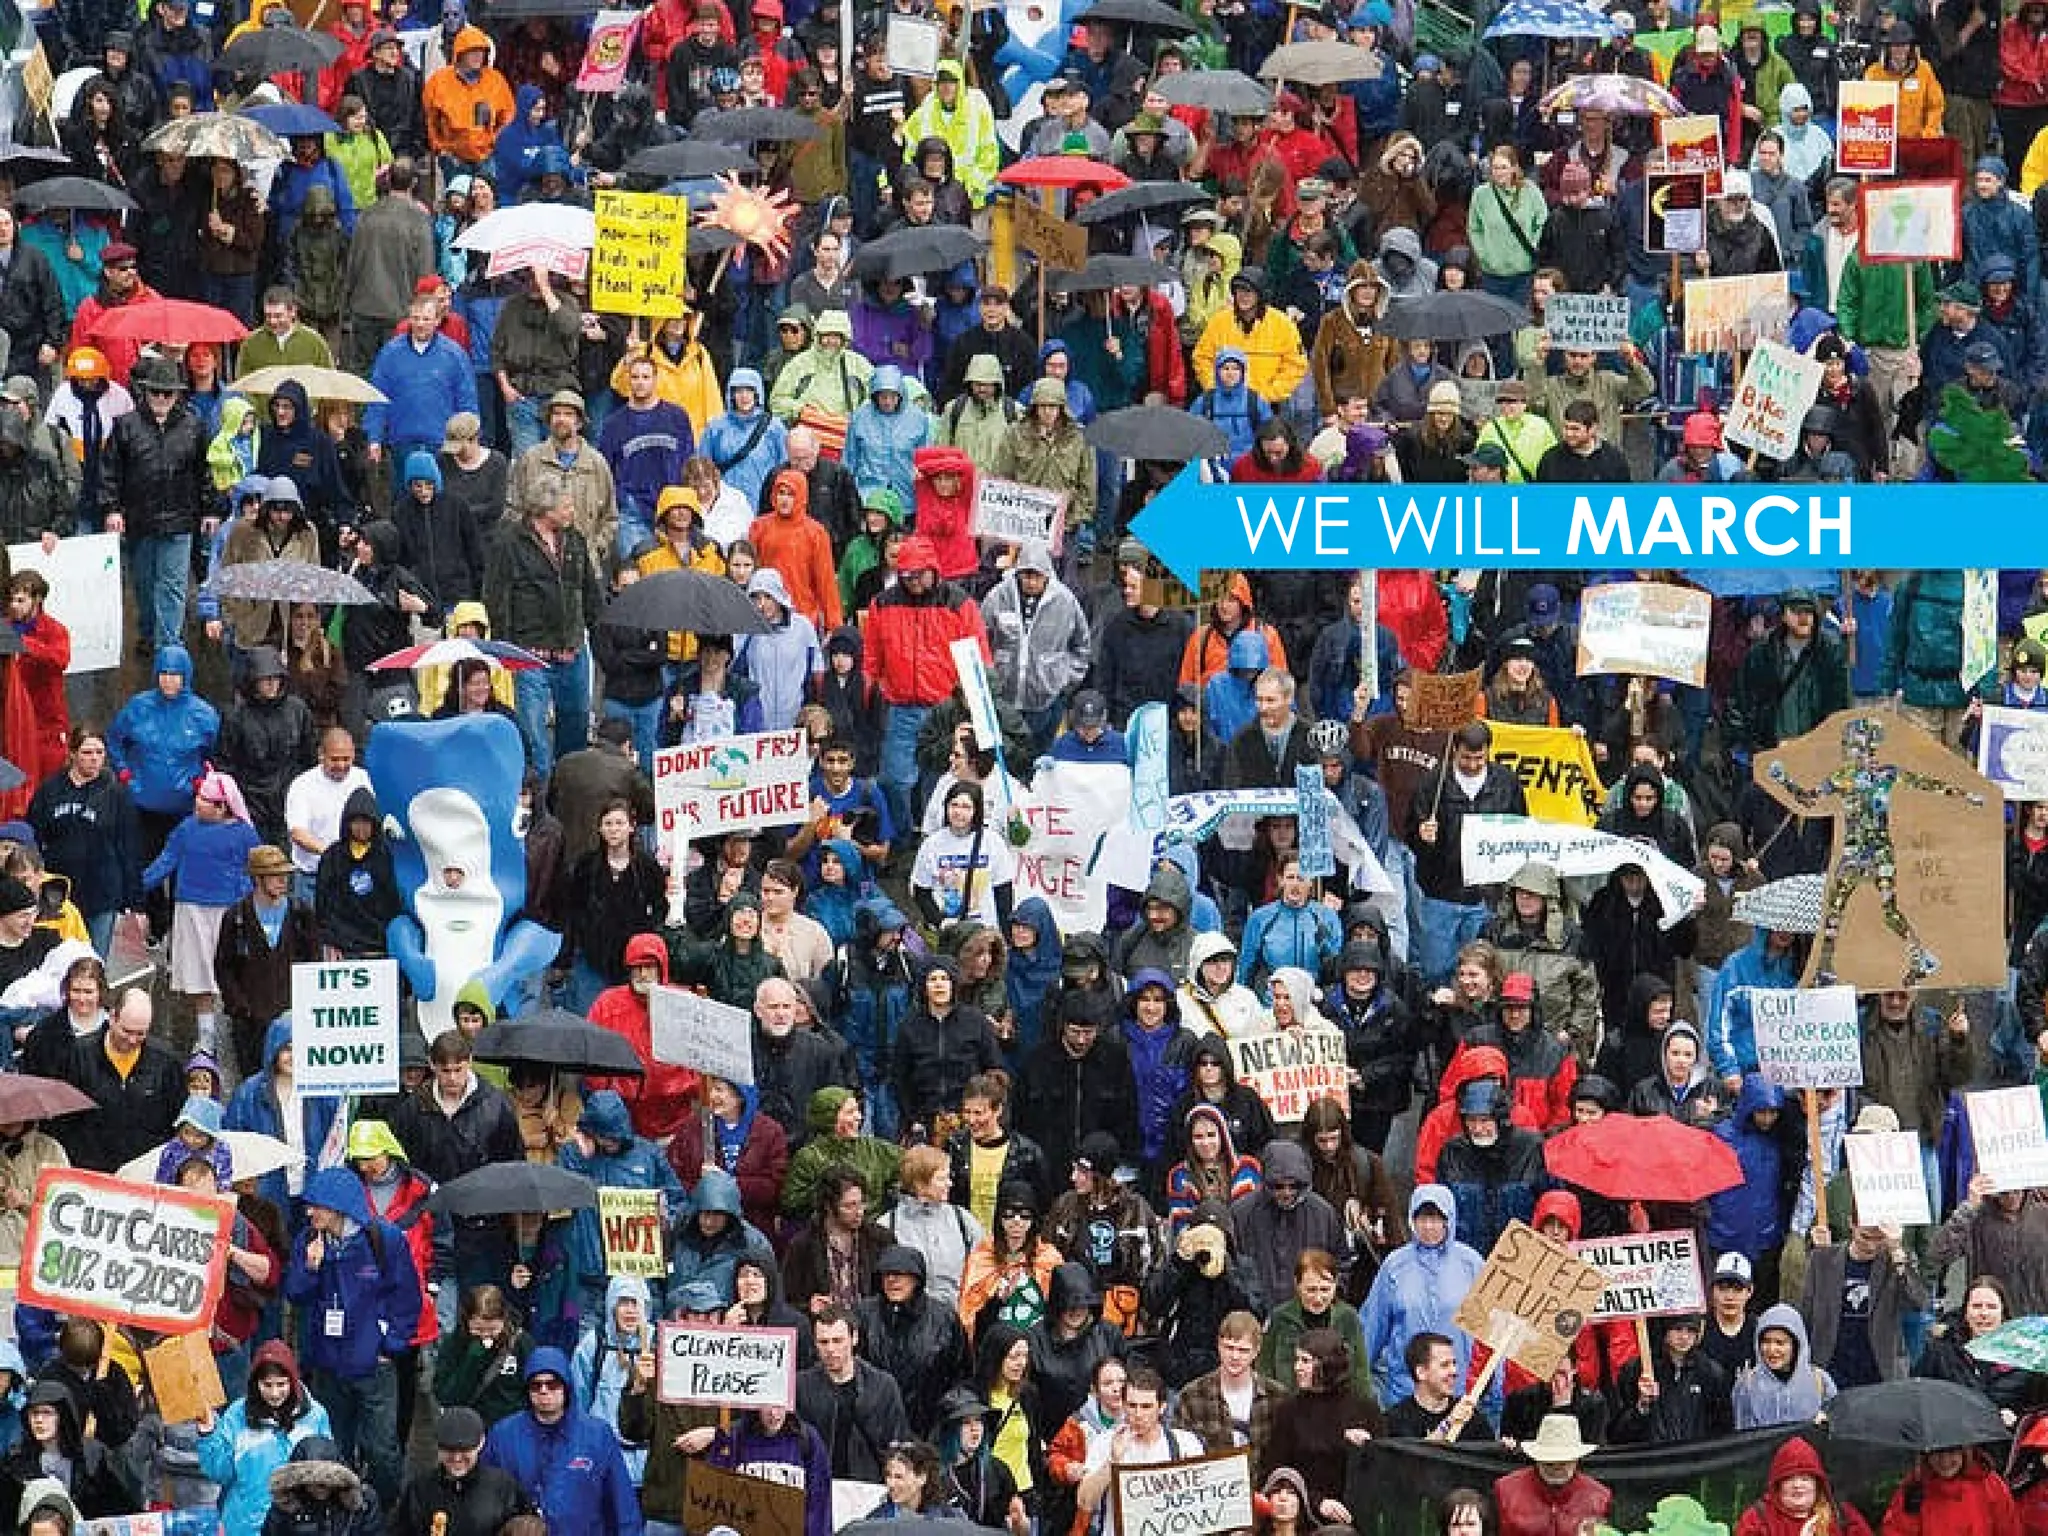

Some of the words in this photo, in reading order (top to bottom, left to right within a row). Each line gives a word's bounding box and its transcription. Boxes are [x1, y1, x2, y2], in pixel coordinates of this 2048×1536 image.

[600, 228, 627, 241] now
[599, 247, 627, 267] kids
[637, 252, 661, 270] will
[597, 271, 632, 293] thank
[642, 272, 678, 304] you!
[756, 732, 800, 762] FRY
[718, 781, 804, 822] FUTURE
[318, 967, 371, 990] IT'S
[313, 1006, 381, 1028] TIME
[1760, 995, 1797, 1018] CUT
[1778, 1021, 1857, 1042] CARBON
[307, 1042, 384, 1067] NOW!
[1240, 1035, 1315, 1075] NEWS
[1758, 1046, 1858, 1063] EMISSIONS
[1975, 1087, 2037, 1135] NO
[1853, 1133, 1916, 1171] NO
[1977, 1129, 2044, 1156] MORE
[1857, 1171, 1921, 1191] MORE
[50, 1191, 126, 1244] CUT
[125, 1207, 215, 1265] CARBS
[605, 1215, 657, 1255] HOT
[39, 1240, 102, 1291] 80%
[122, 1257, 204, 1315] 2050
[1497, 1228, 1601, 1298] STEP
[691, 1363, 768, 1395] PLEASE
[1126, 1466, 1209, 1499] CLIMATE
[1153, 1480, 1244, 1513] JUSTICE
[1139, 1502, 1224, 1536] NOW
